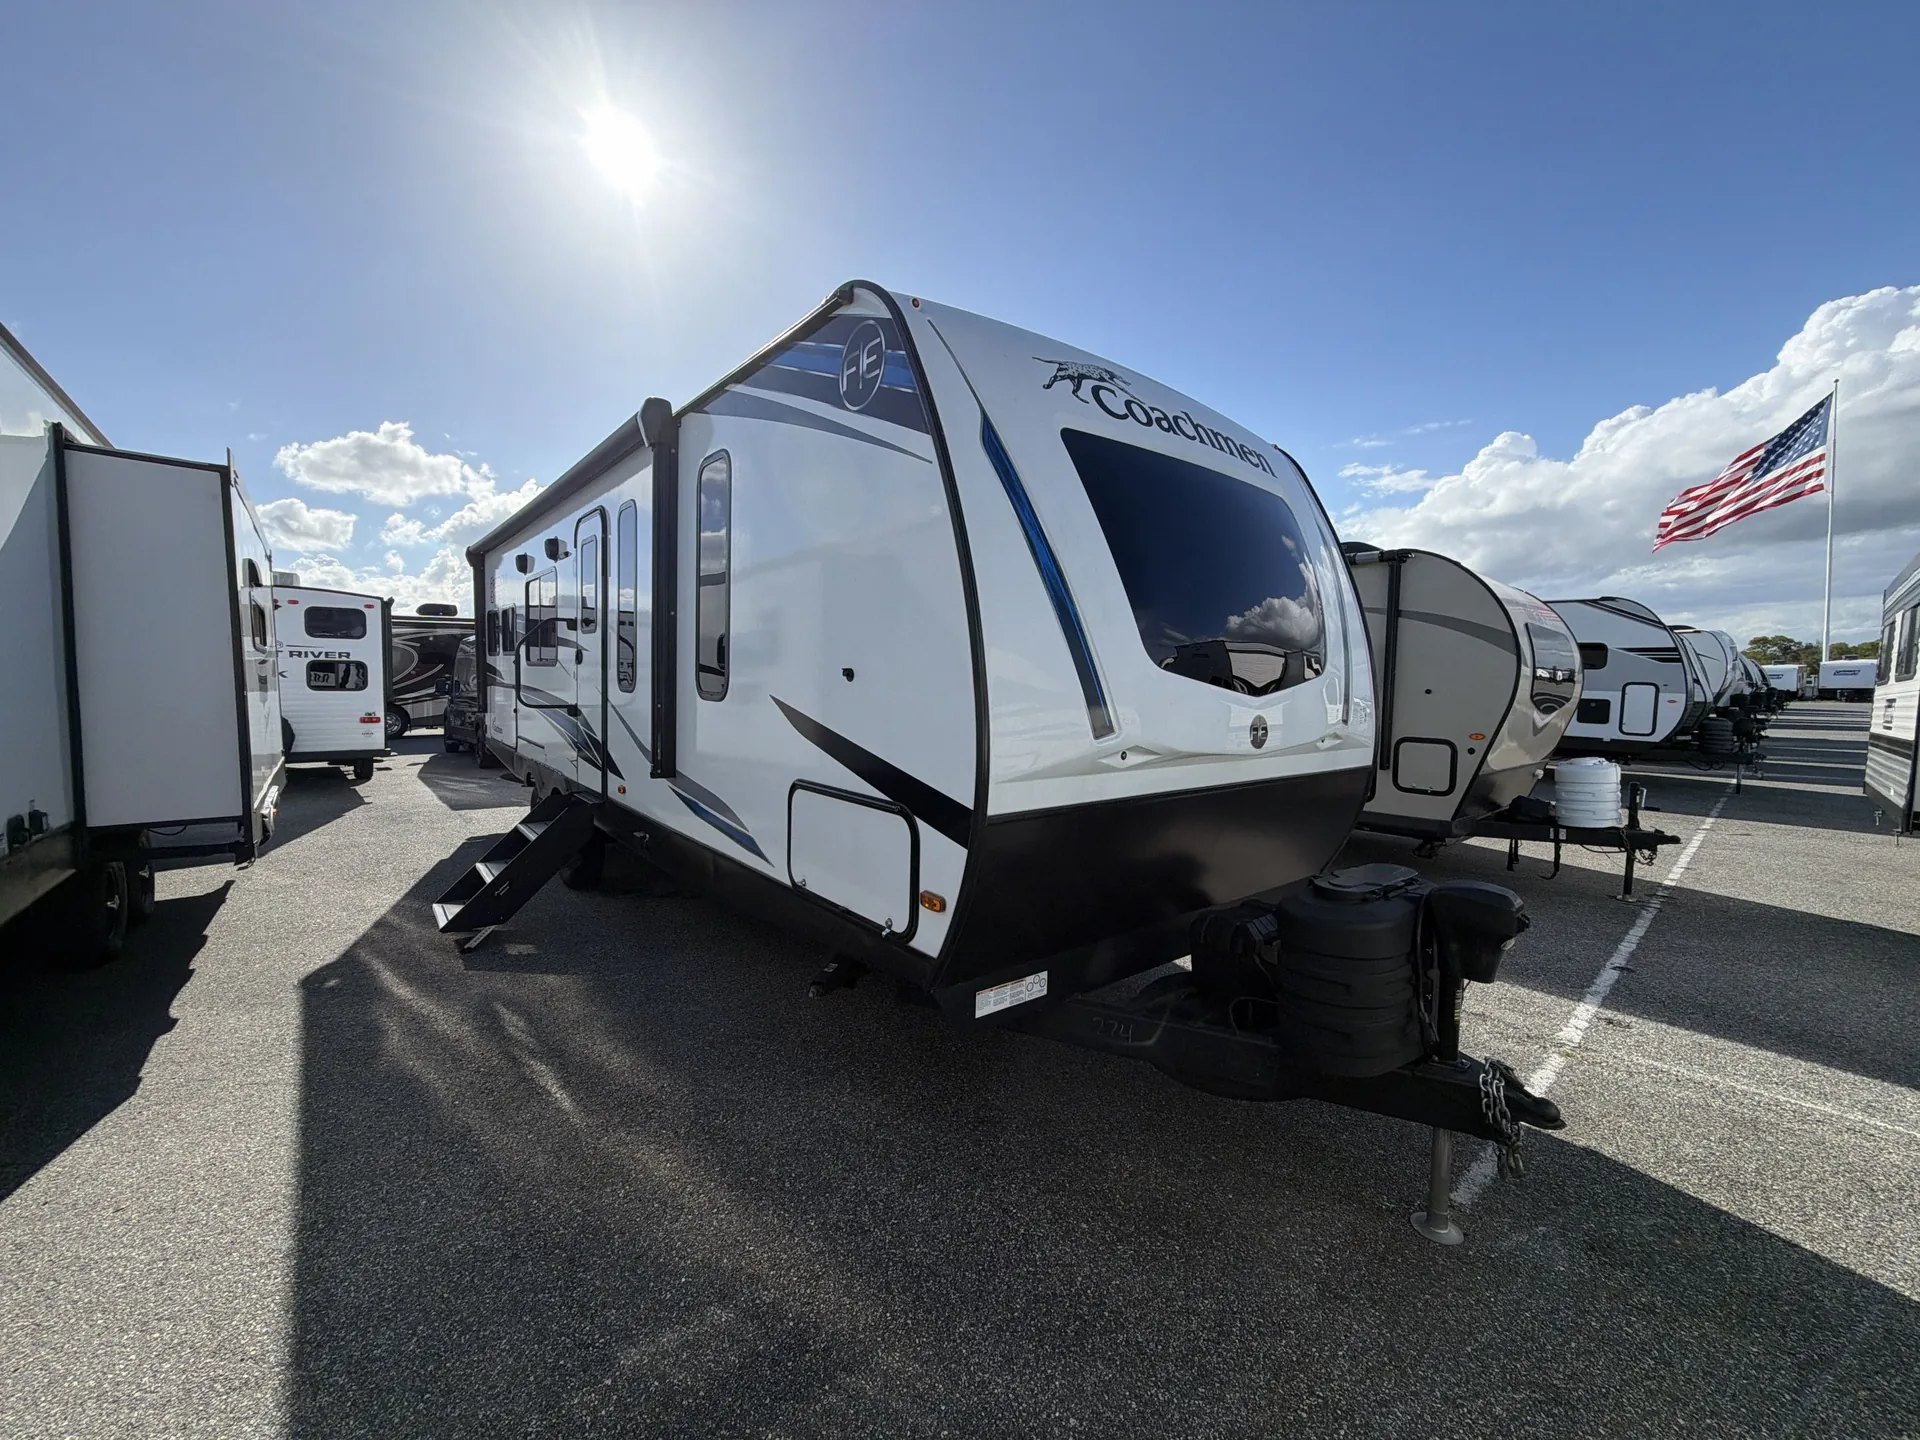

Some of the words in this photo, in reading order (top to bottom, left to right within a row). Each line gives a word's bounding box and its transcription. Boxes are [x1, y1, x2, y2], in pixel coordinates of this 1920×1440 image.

[1091, 385, 1278, 479] Coachmen
[288, 650, 351, 659] RIVER
[1091, 1016, 1134, 1044] 274
